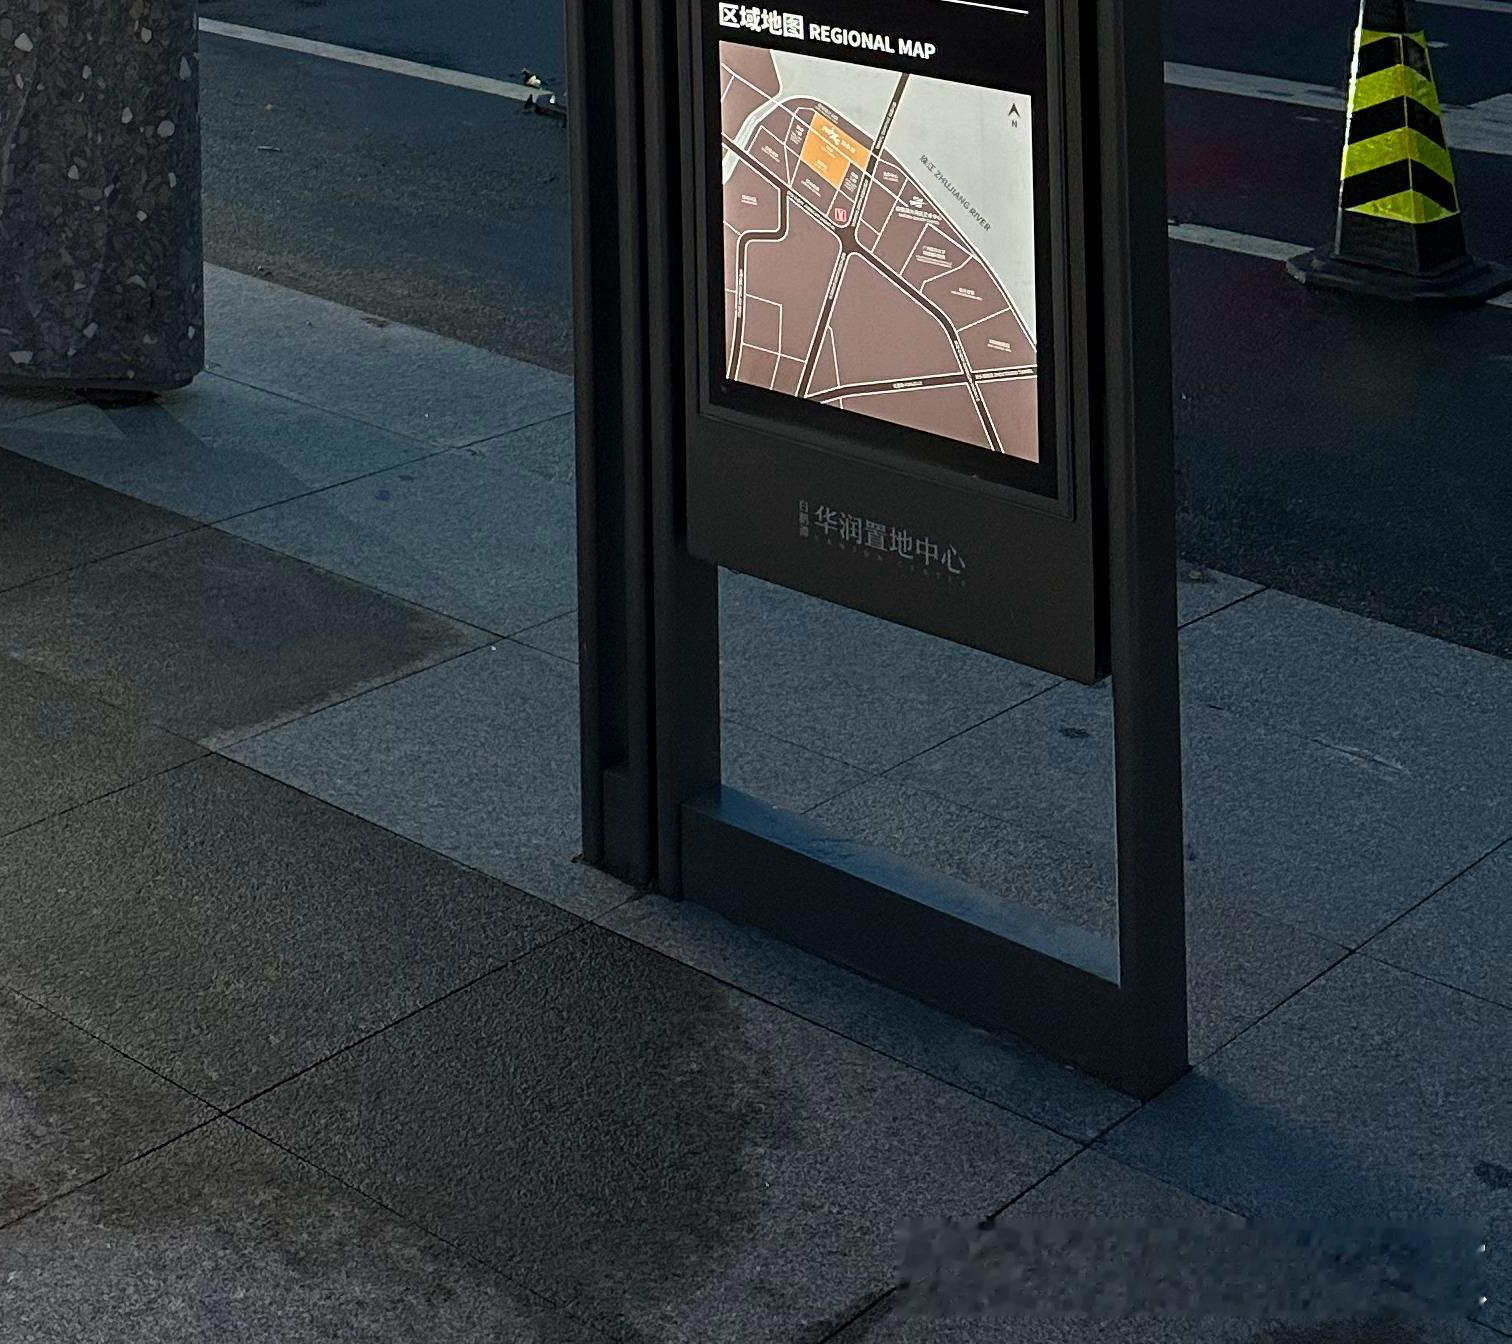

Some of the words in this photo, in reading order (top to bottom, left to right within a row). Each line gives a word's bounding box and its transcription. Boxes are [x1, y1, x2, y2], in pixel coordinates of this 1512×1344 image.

[719, 2, 805, 40] 区域地图
[809, 23, 895, 54] REGIONAL
[898, 38, 936, 60] MAP
[934, 171, 970, 210] ZHUJIANG
[968, 207, 992, 232] RIVER
[815, 505, 966, 574] 华润置地中心
